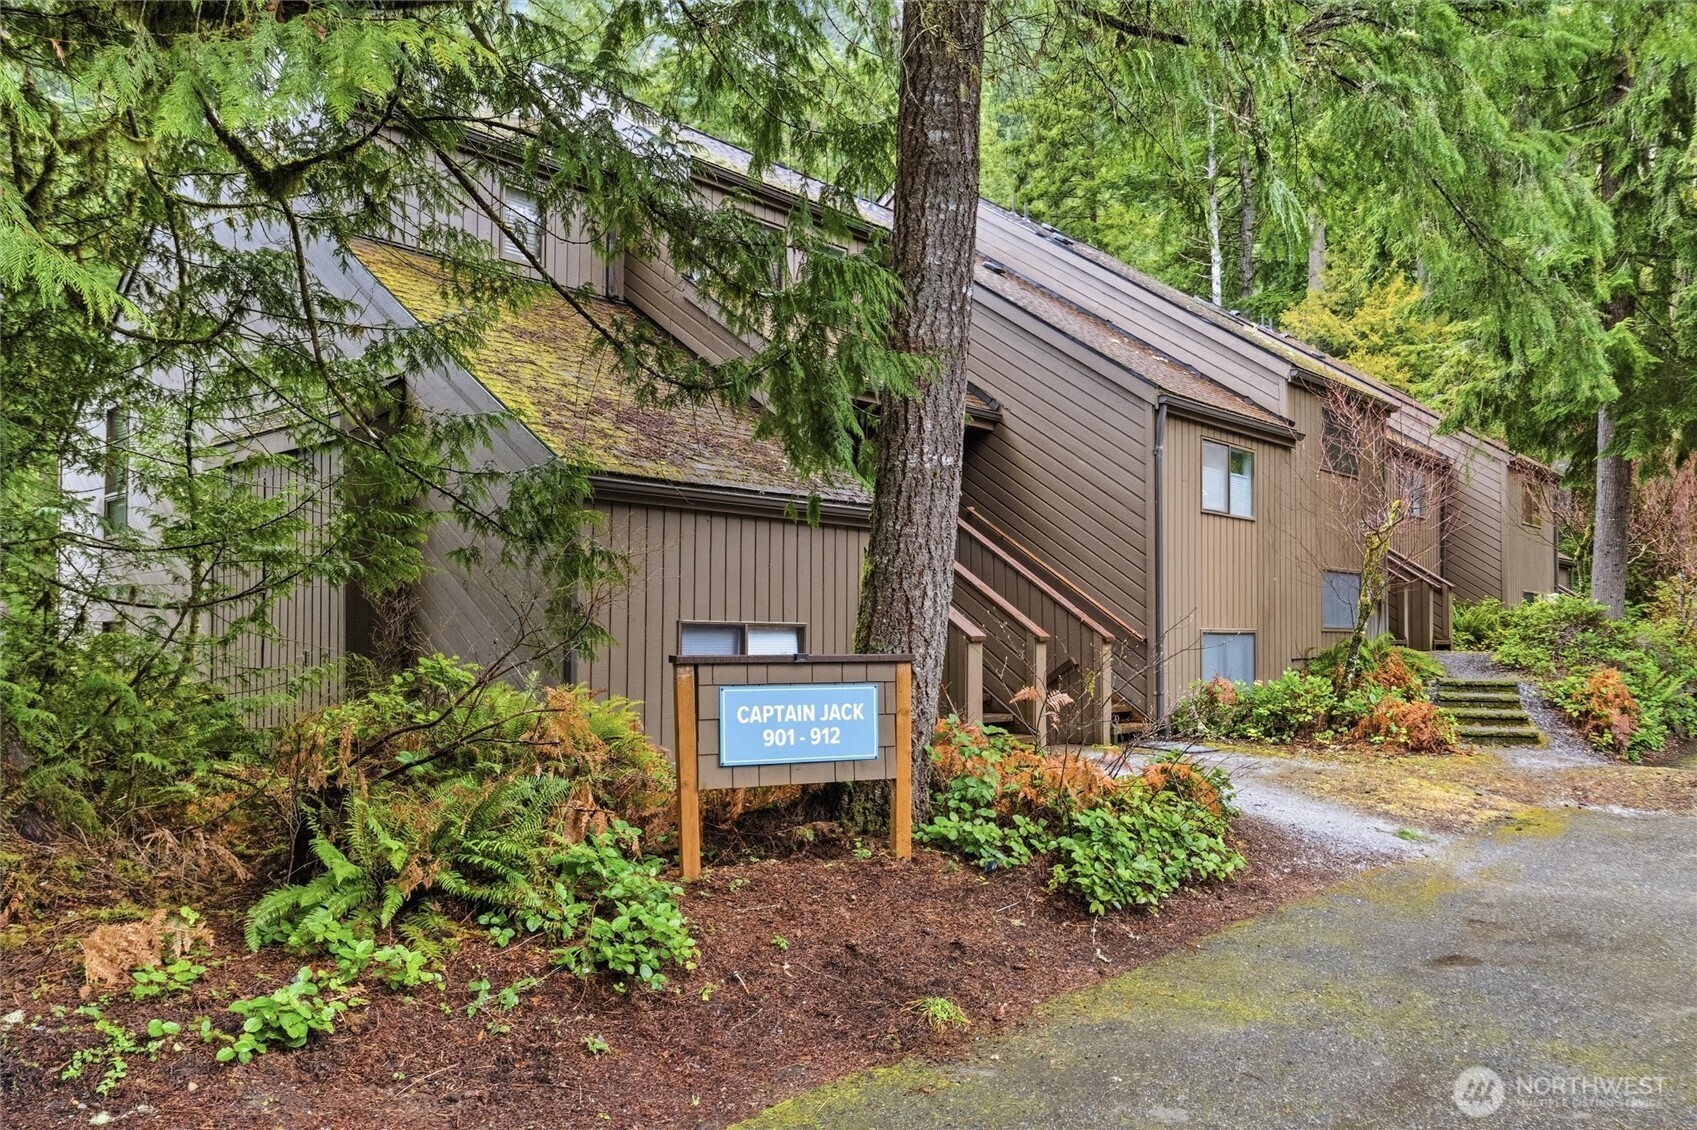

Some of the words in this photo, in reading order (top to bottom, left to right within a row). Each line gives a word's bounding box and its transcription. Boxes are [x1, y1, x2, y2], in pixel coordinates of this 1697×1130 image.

[737, 704, 815, 724] CAPTAIN
[820, 703, 864, 721] JACK
[763, 729, 794, 746] 901
[810, 727, 840, 745] 912
